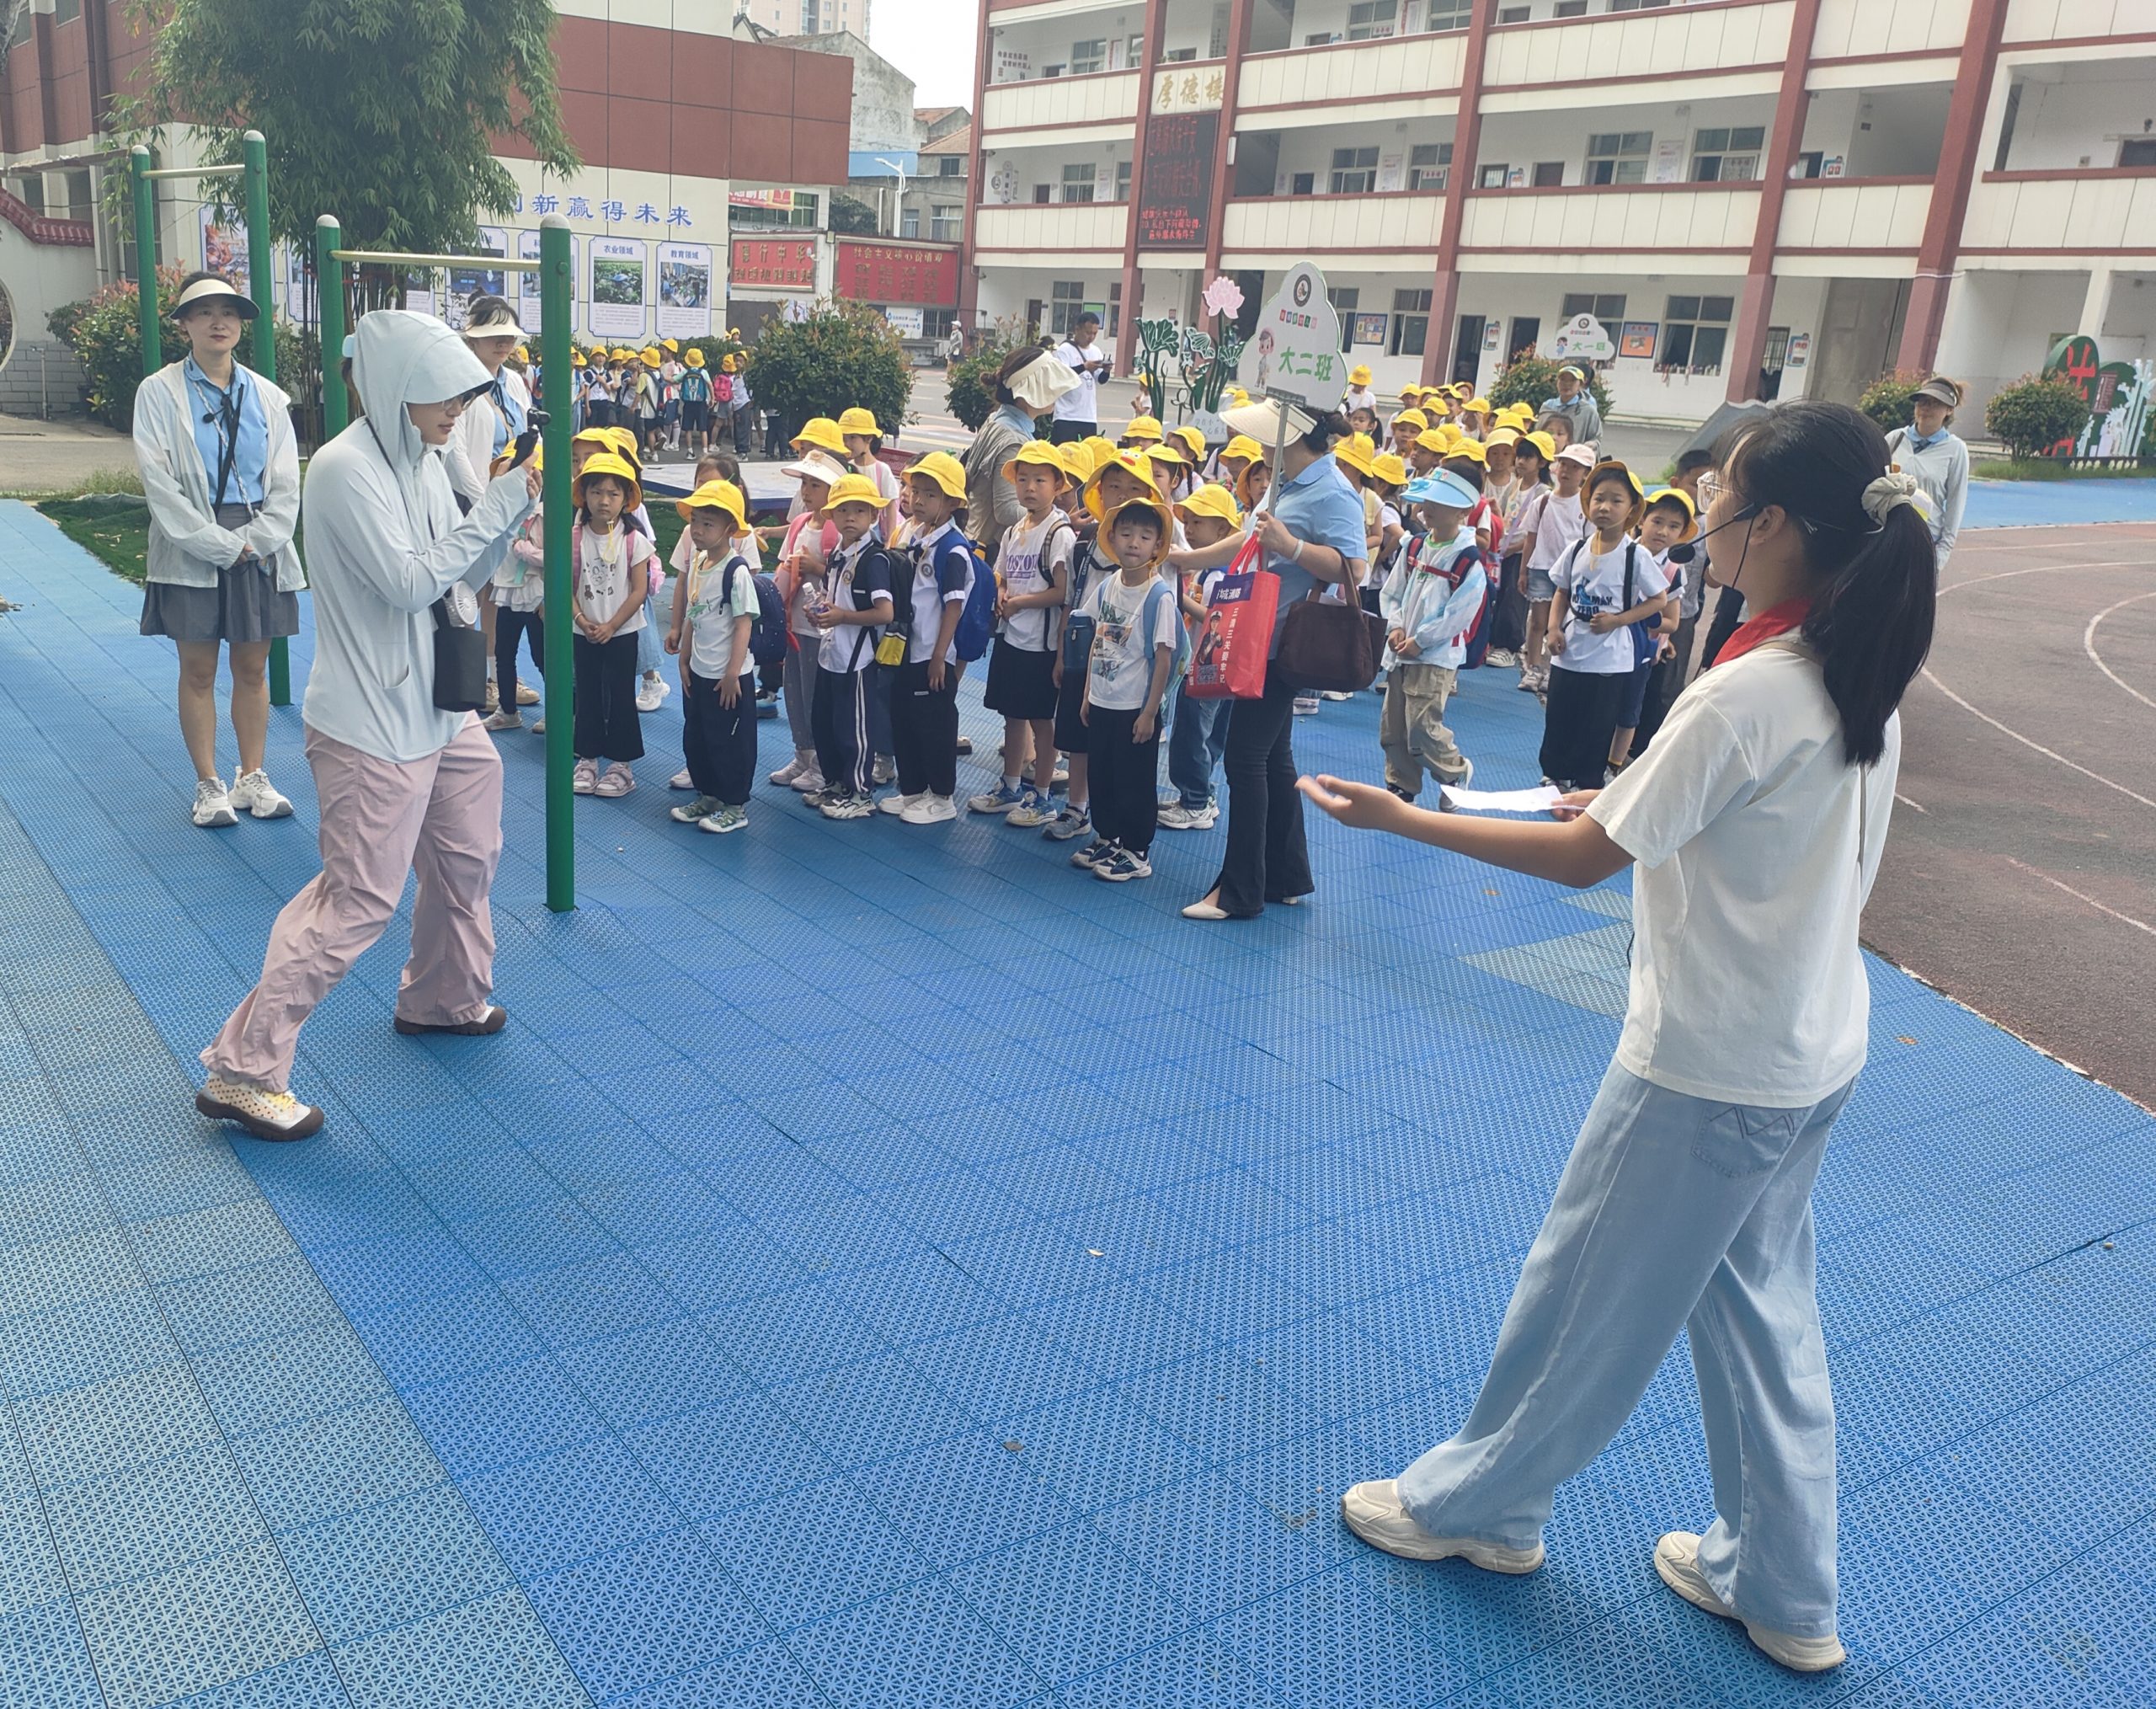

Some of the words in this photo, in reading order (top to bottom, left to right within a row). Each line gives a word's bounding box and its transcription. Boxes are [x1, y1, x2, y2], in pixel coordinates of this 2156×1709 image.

[515, 193, 693, 227] 新赢得未来
[603, 244, 634, 255] 农业领域
[670, 250, 700, 260] 教育领域
[1278, 346, 1334, 382] 大二班
